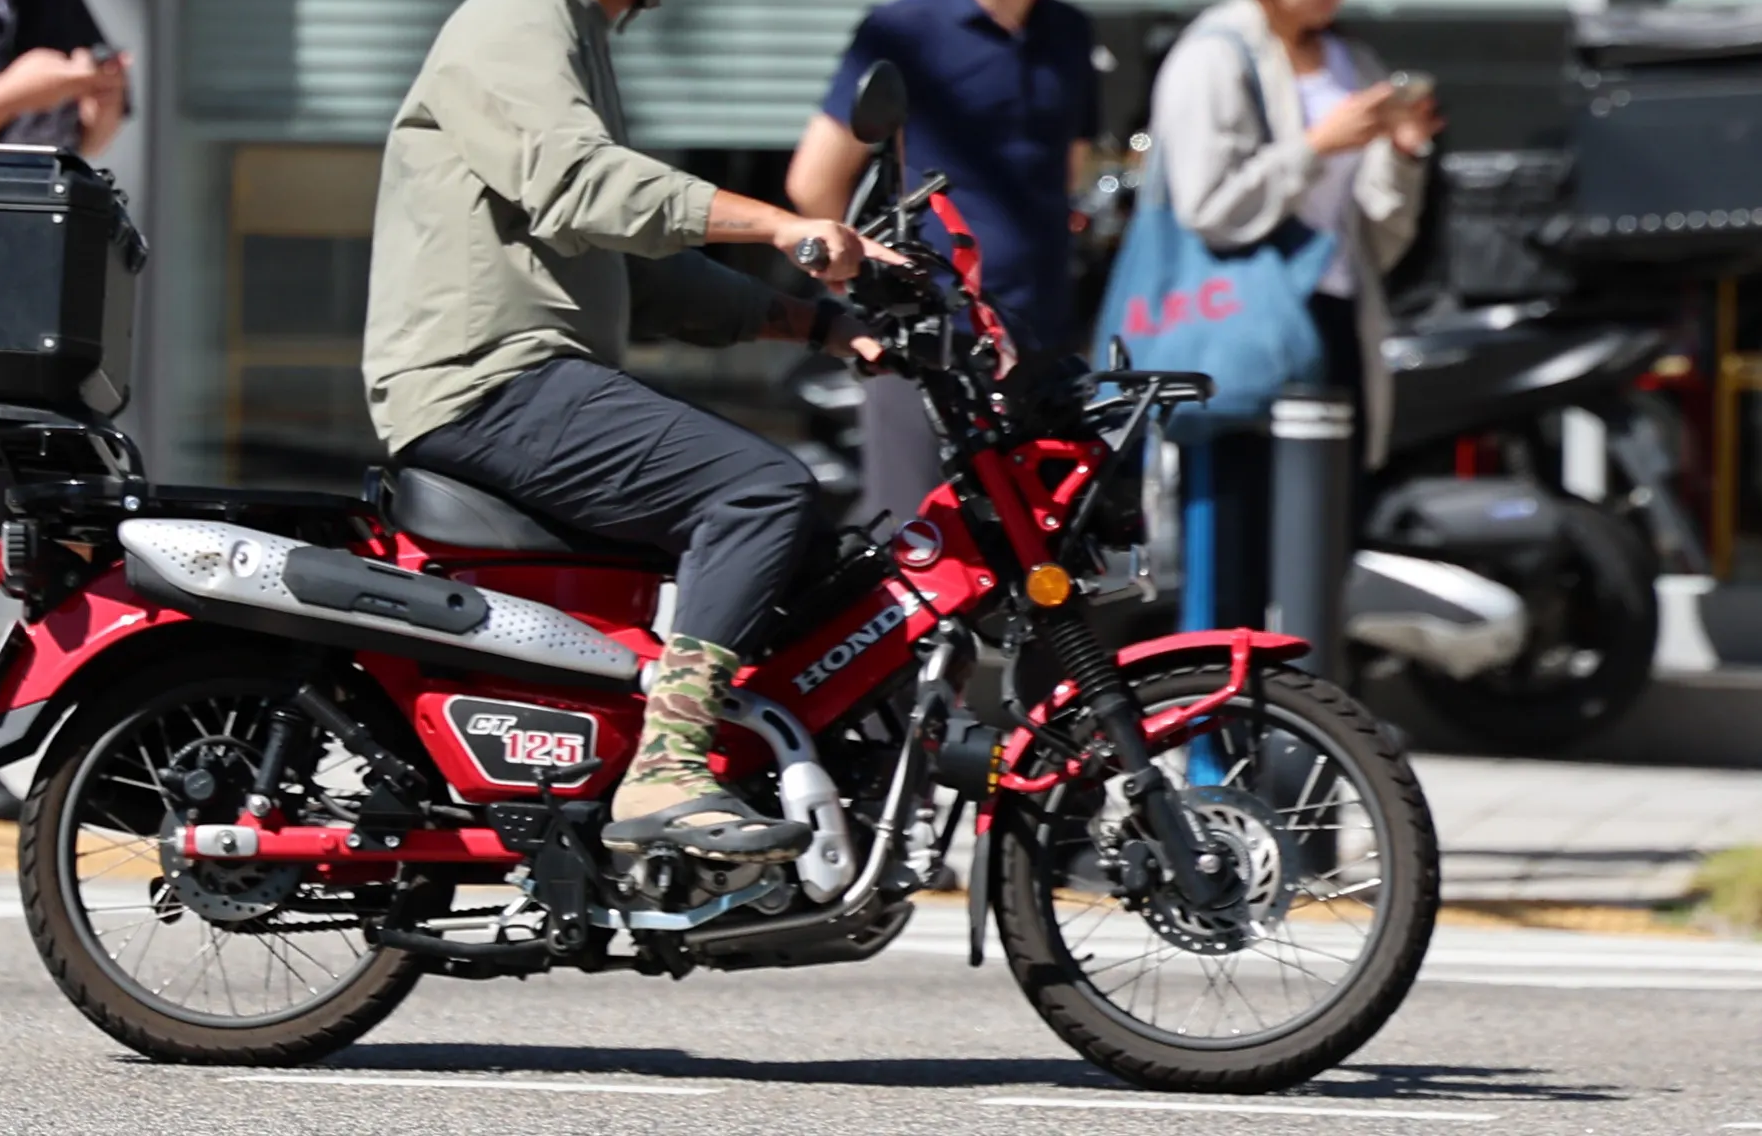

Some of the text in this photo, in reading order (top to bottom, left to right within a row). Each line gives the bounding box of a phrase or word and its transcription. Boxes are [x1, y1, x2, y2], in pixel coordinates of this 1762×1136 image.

[791, 590, 938, 696] HONDA
[466, 713, 585, 767] CT 125
